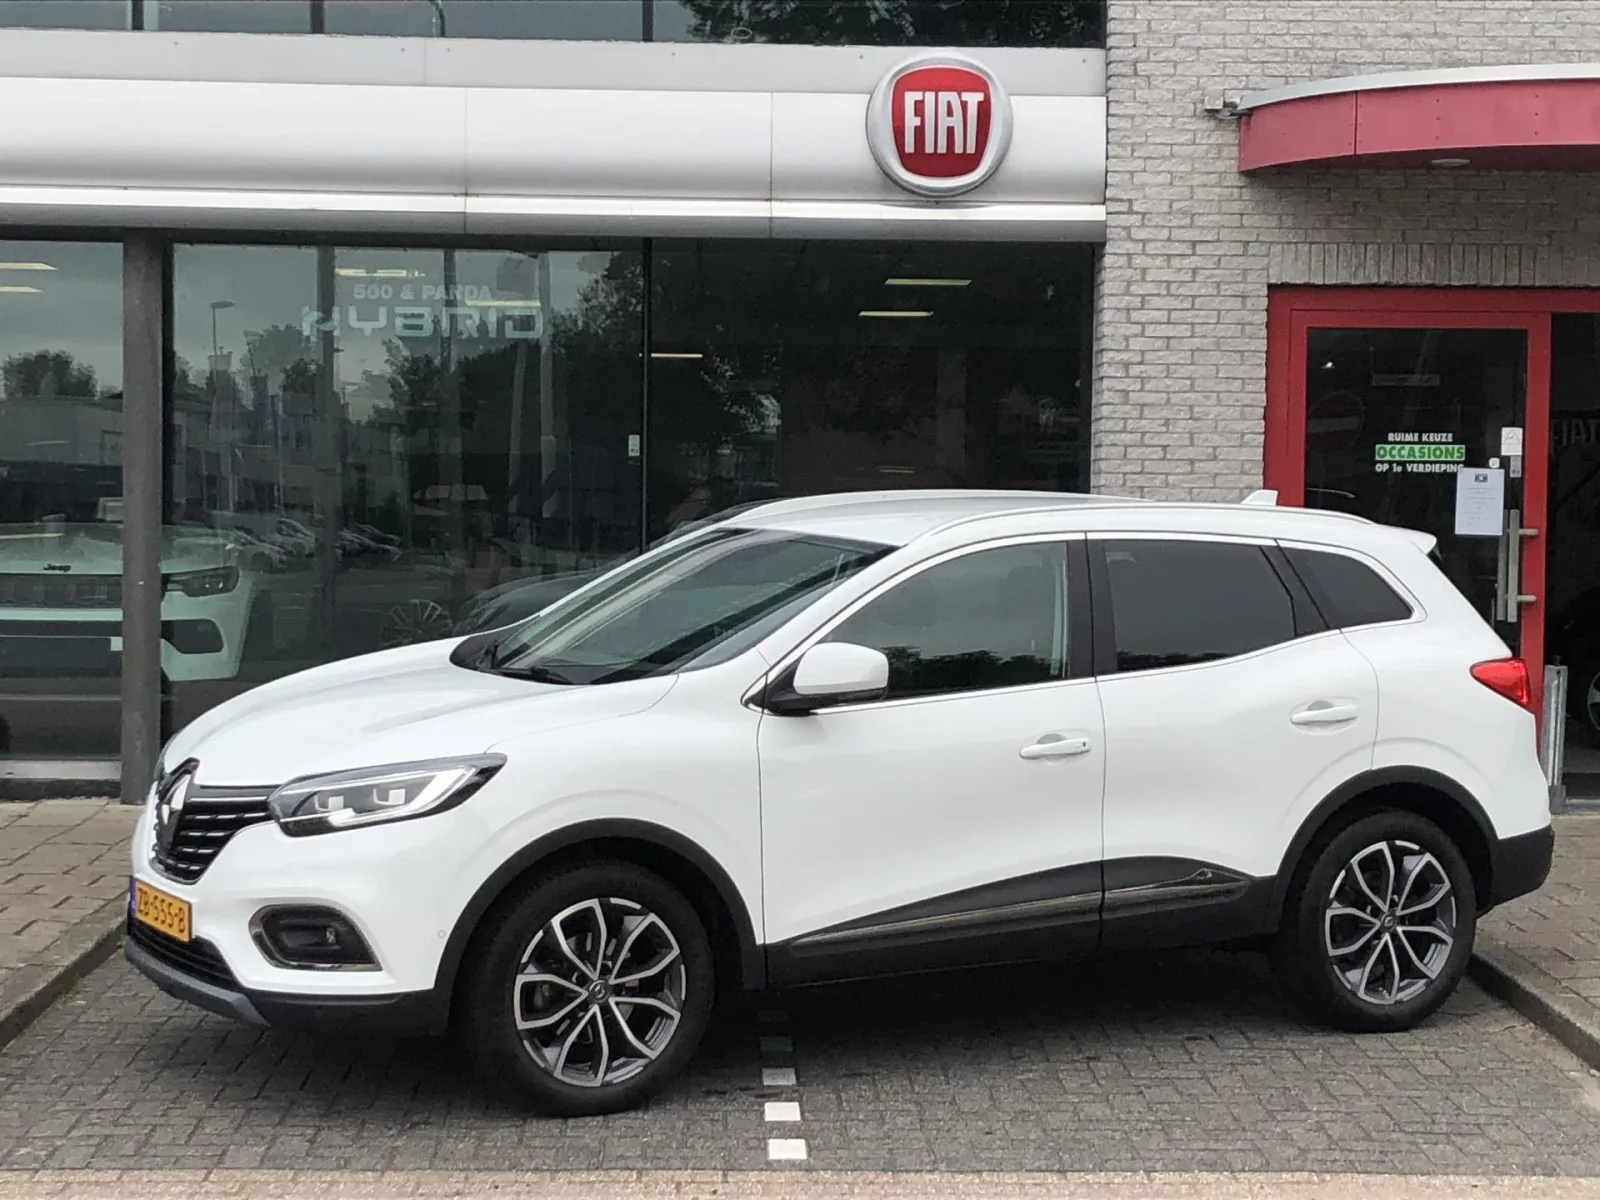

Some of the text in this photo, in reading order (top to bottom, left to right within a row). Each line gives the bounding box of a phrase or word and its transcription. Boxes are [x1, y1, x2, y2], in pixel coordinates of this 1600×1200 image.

[904, 90, 985, 154] FIAT
[353, 284, 492, 301] 500 & PANDA
[1388, 433, 1453, 442] RUIME KEUZE
[1377, 446, 1464, 459] OCCASIONS
[1375, 464, 1389, 472] OP
[43, 563, 72, 572] Jeep
